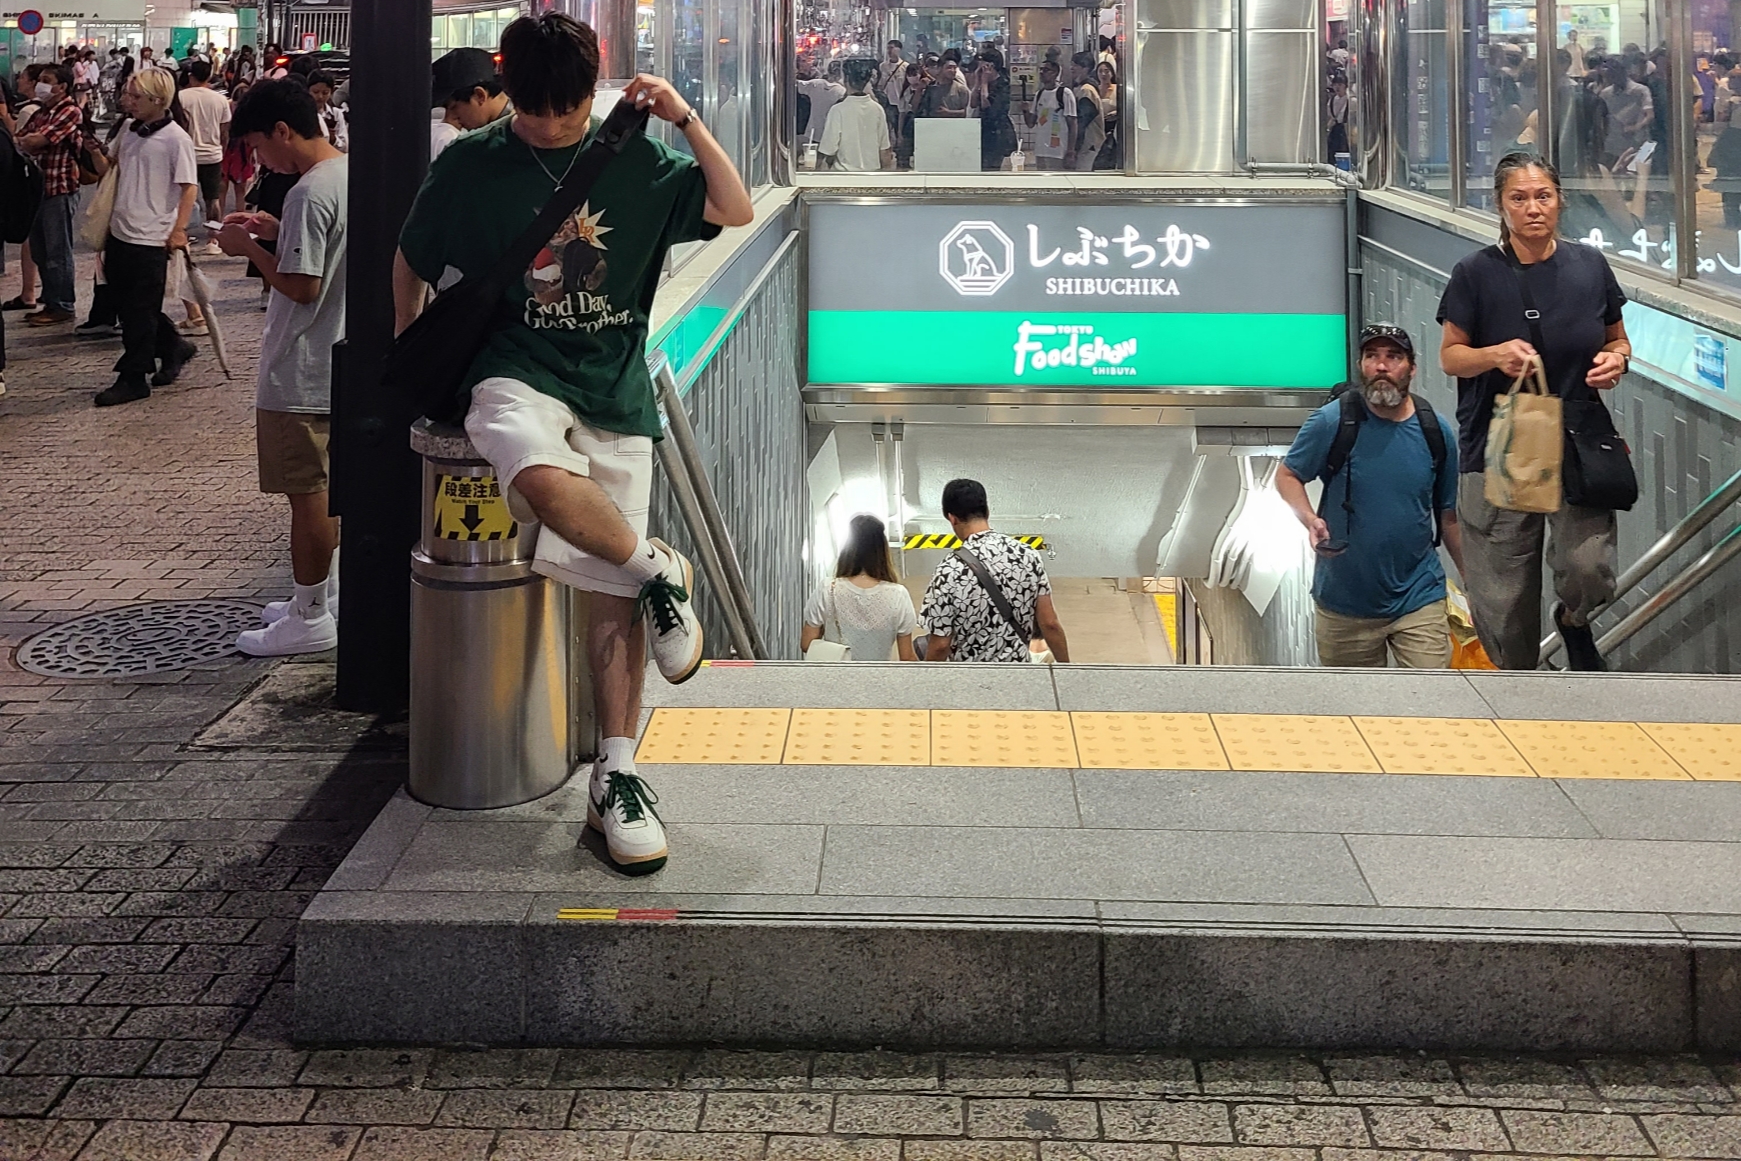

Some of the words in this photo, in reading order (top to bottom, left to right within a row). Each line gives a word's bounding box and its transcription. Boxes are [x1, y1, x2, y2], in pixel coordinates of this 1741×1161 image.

[1025, 223, 1211, 270] しぶちか
[1045, 278, 1180, 297] SHIBUCHIKA
[1056, 324, 1095, 335] TOKYU
[1013, 319, 1138, 377] Foodshow
[1091, 366, 1138, 376] SHIBUYA
